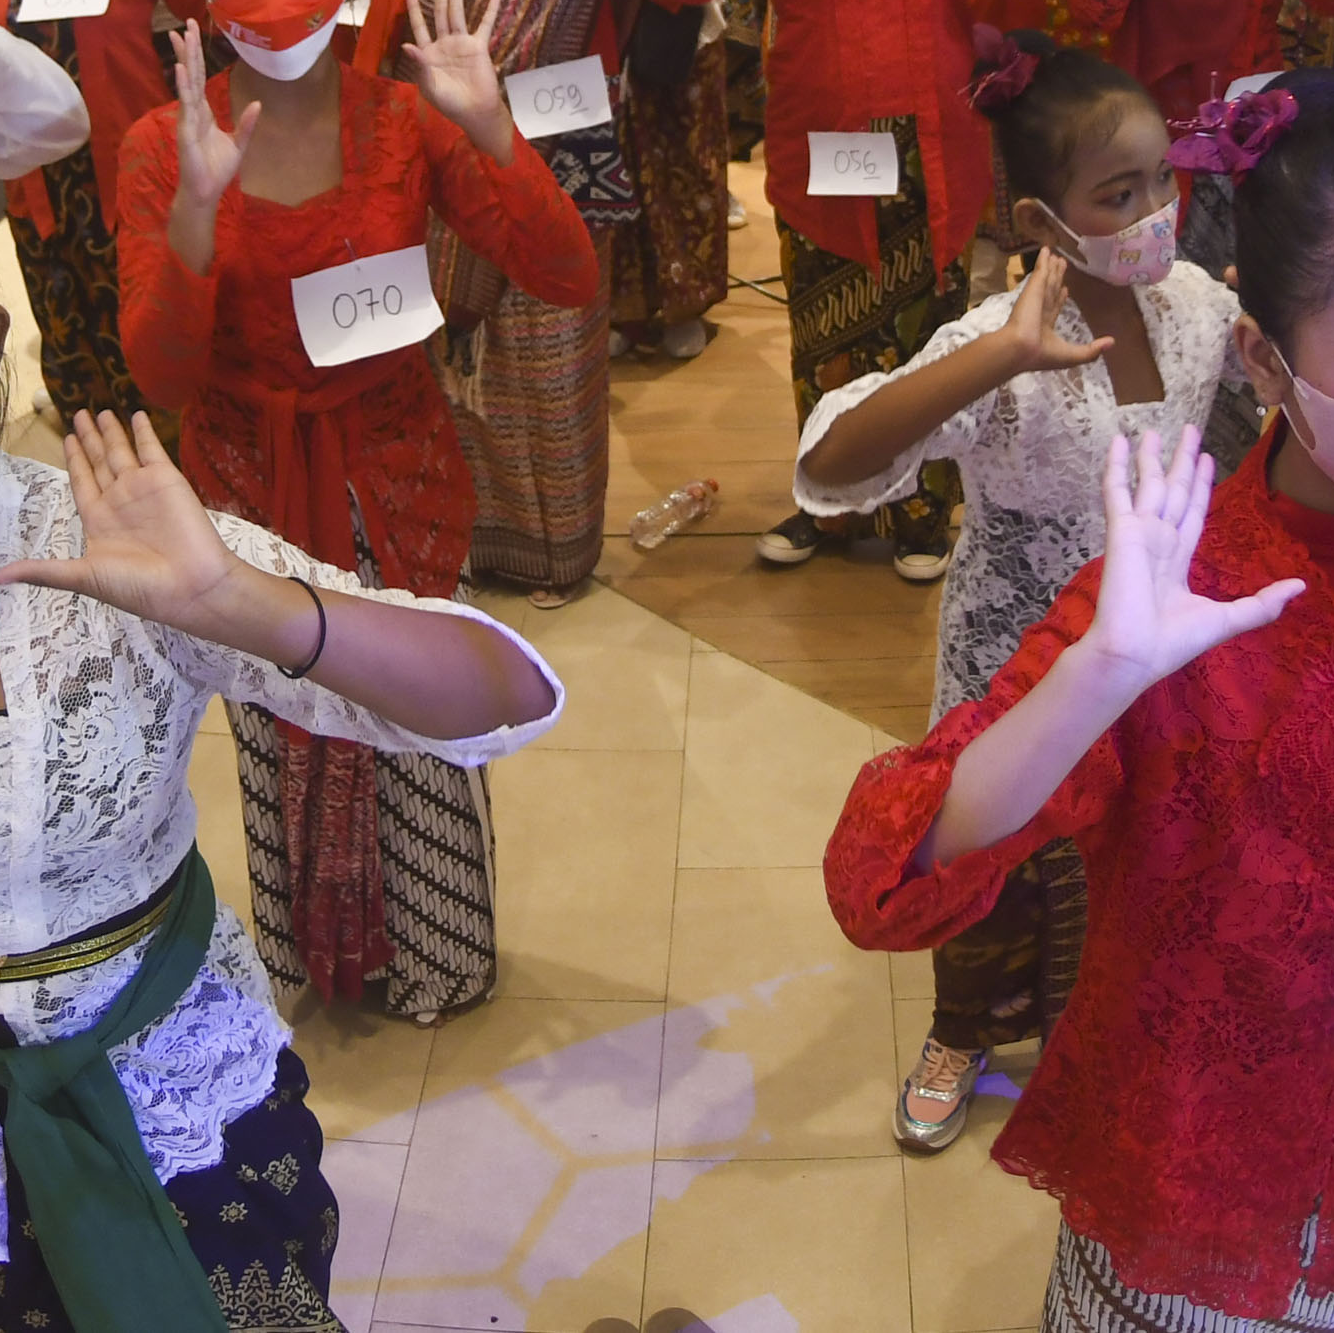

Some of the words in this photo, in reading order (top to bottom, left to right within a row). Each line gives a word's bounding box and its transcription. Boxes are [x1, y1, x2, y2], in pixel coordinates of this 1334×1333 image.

[533, 83, 583, 115] 059
[834, 149, 876, 175] 056
[332, 284, 403, 329] 070
